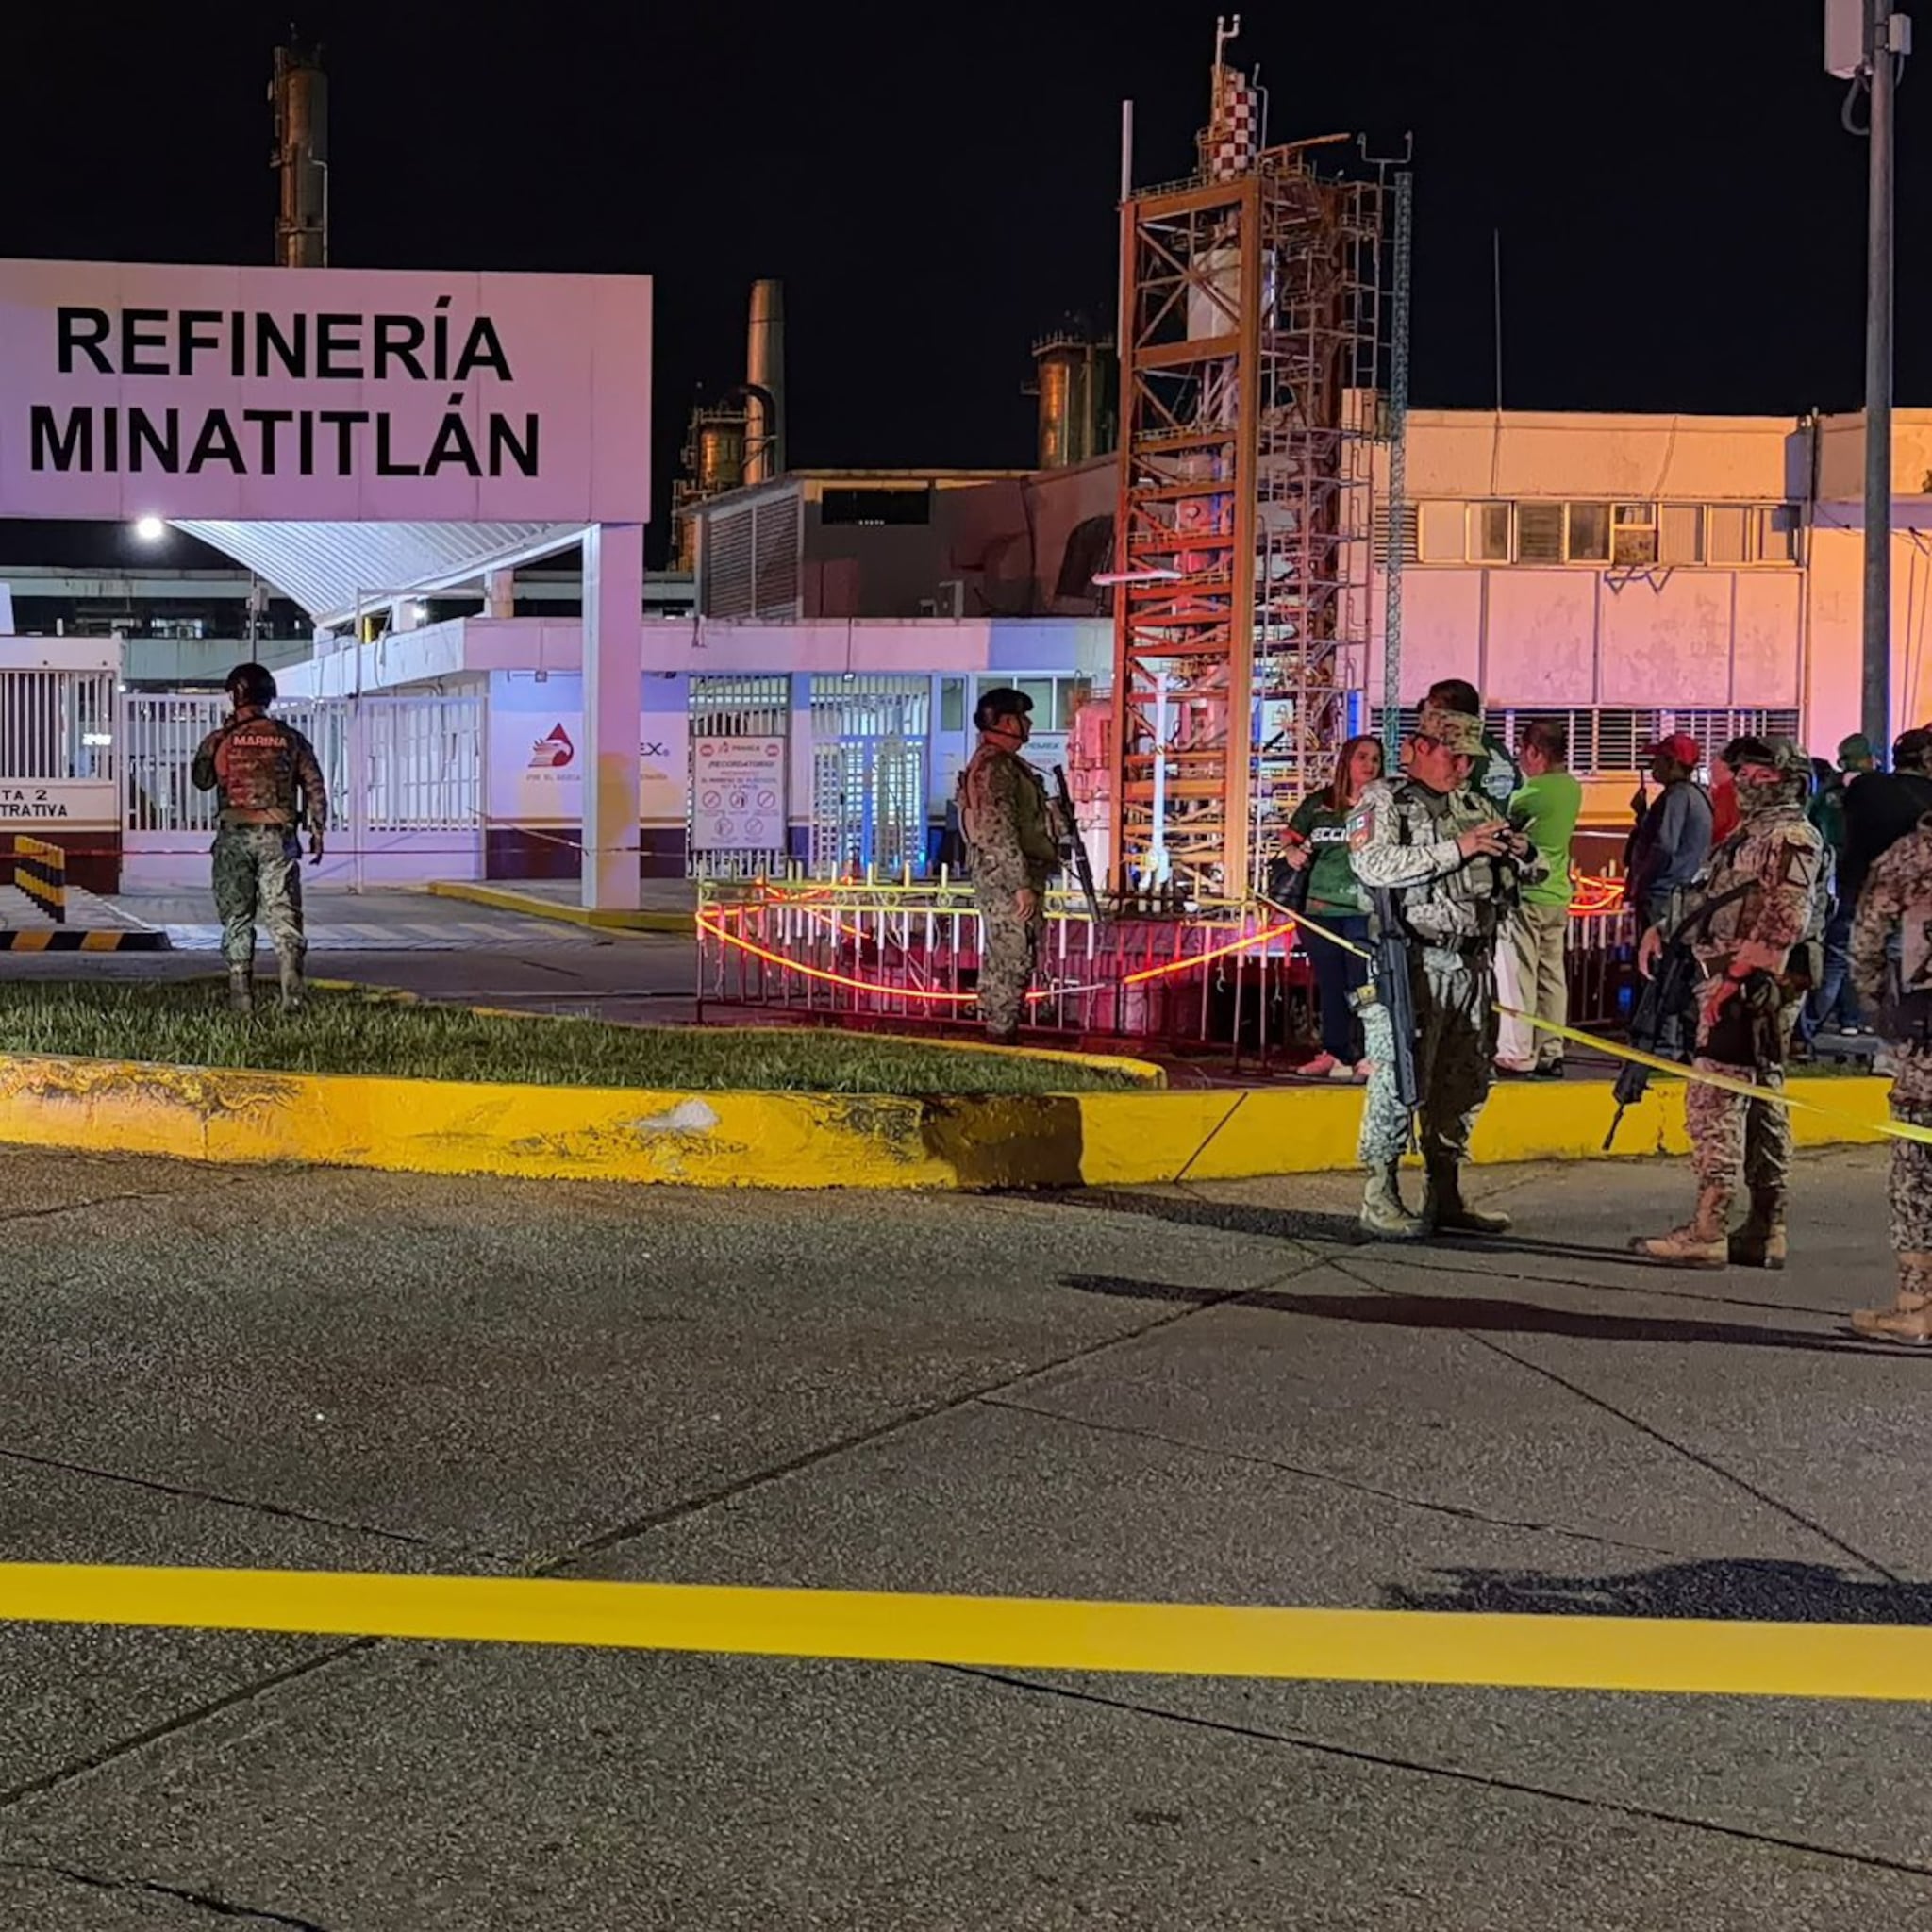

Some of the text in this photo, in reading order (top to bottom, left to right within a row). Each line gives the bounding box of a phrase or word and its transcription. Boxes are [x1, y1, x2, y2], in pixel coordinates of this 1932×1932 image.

[57, 295, 514, 382] REFINERÍA
[29, 391, 540, 477] MINATITLÁN
[233, 735, 287, 748] MARINA
[34, 789, 48, 801] 2
